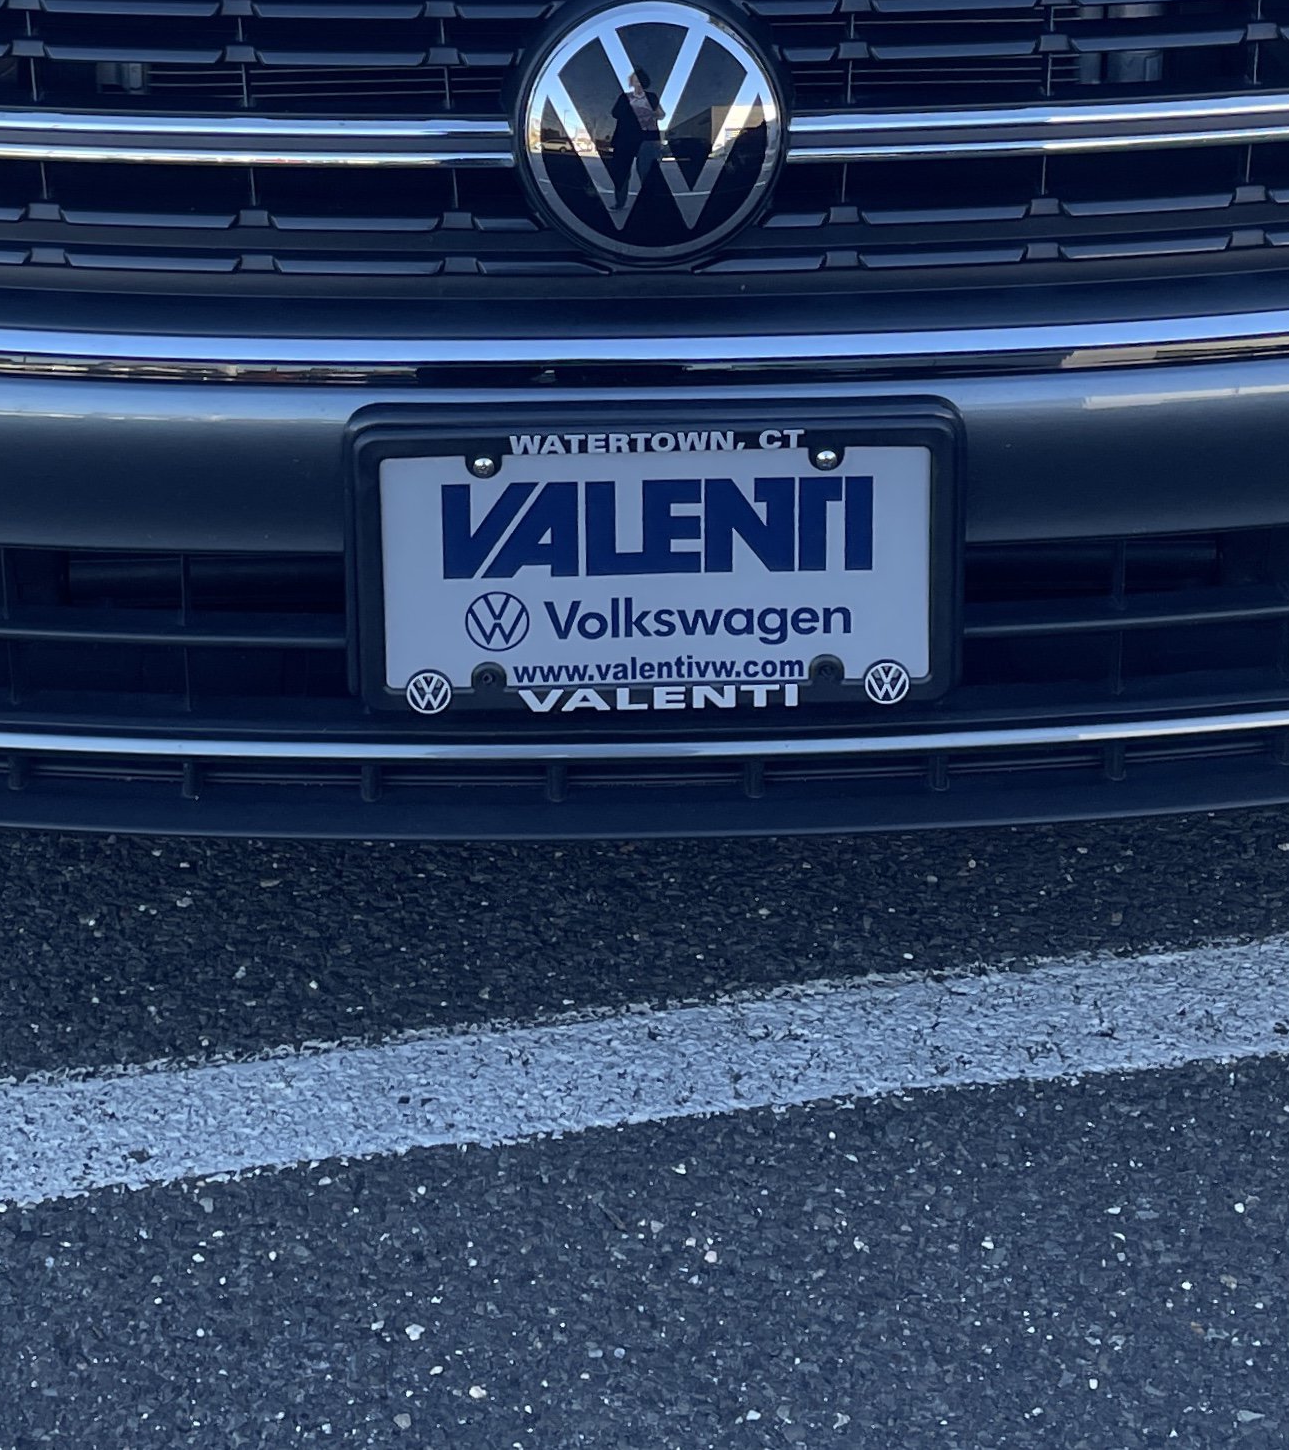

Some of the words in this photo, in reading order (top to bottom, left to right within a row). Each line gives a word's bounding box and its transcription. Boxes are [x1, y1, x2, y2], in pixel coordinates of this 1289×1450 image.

[509, 430, 746, 455] WATERTOWN,
[758, 429, 805, 450] CT
[440, 476, 874, 580] VALENTI
[543, 596, 853, 645] Volkswagen
[512, 654, 805, 683] www.valentivw.com
[517, 683, 799, 713] VALENTI
